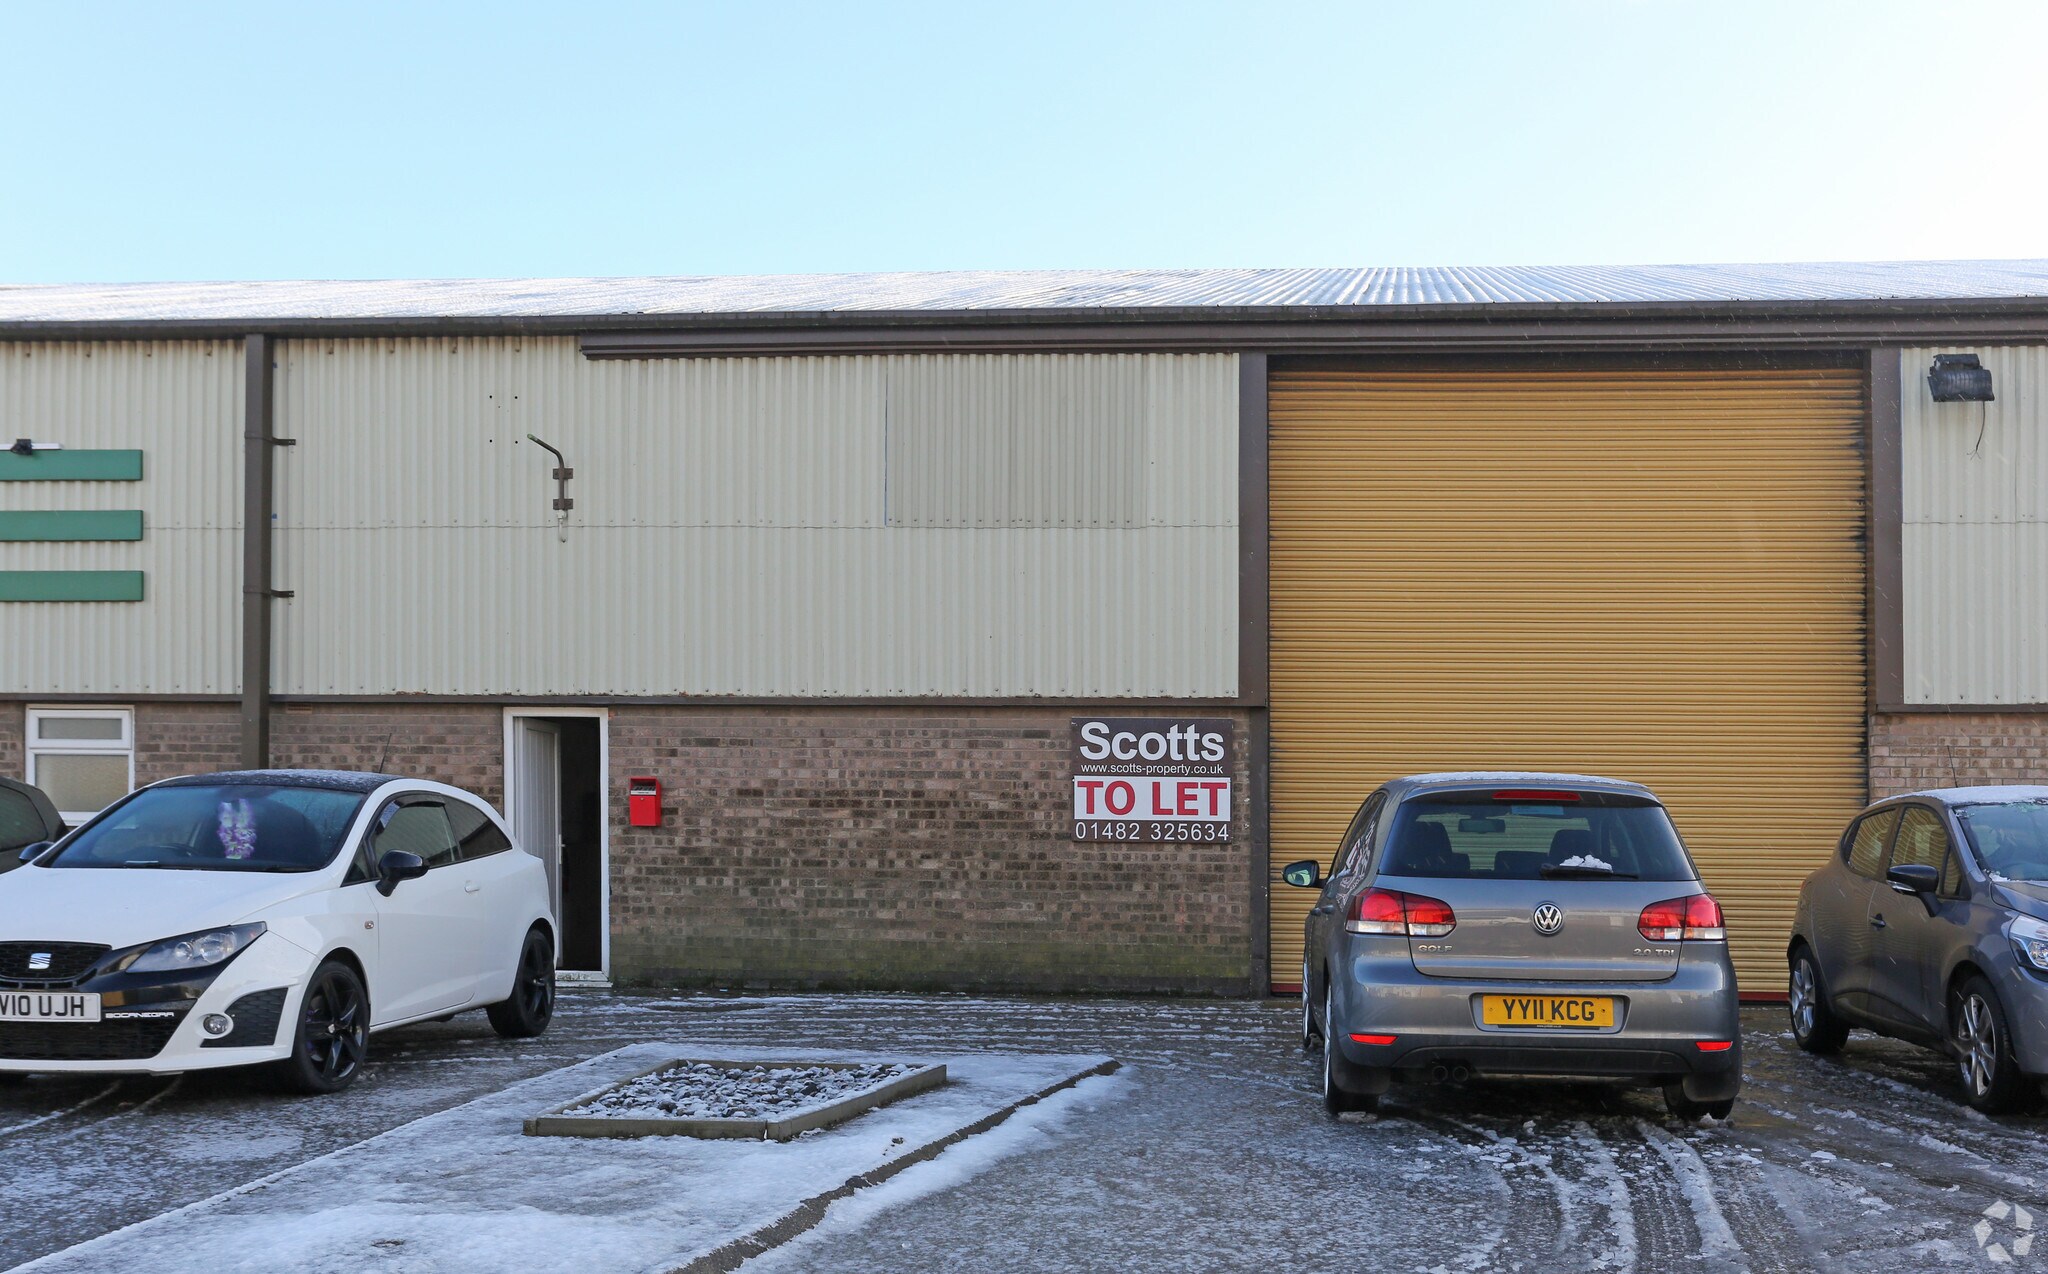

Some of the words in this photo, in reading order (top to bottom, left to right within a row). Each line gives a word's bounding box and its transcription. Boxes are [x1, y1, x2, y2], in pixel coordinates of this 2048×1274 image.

[1079, 721, 1225, 762] Scotts
[1081, 763, 1223, 776] www.scotts-property.co.uk
[1077, 780, 1136, 816] TO
[1152, 781, 1228, 816] LET
[1075, 821, 1141, 840] 01482
[1150, 822, 1229, 841] 325634
[1418, 944, 1452, 953] GOLF
[1655, 949, 1674, 957] TDI
[38, 995, 85, 1017] UJH
[1502, 999, 1544, 1020] YY11
[1551, 1000, 1595, 1021] KCG
